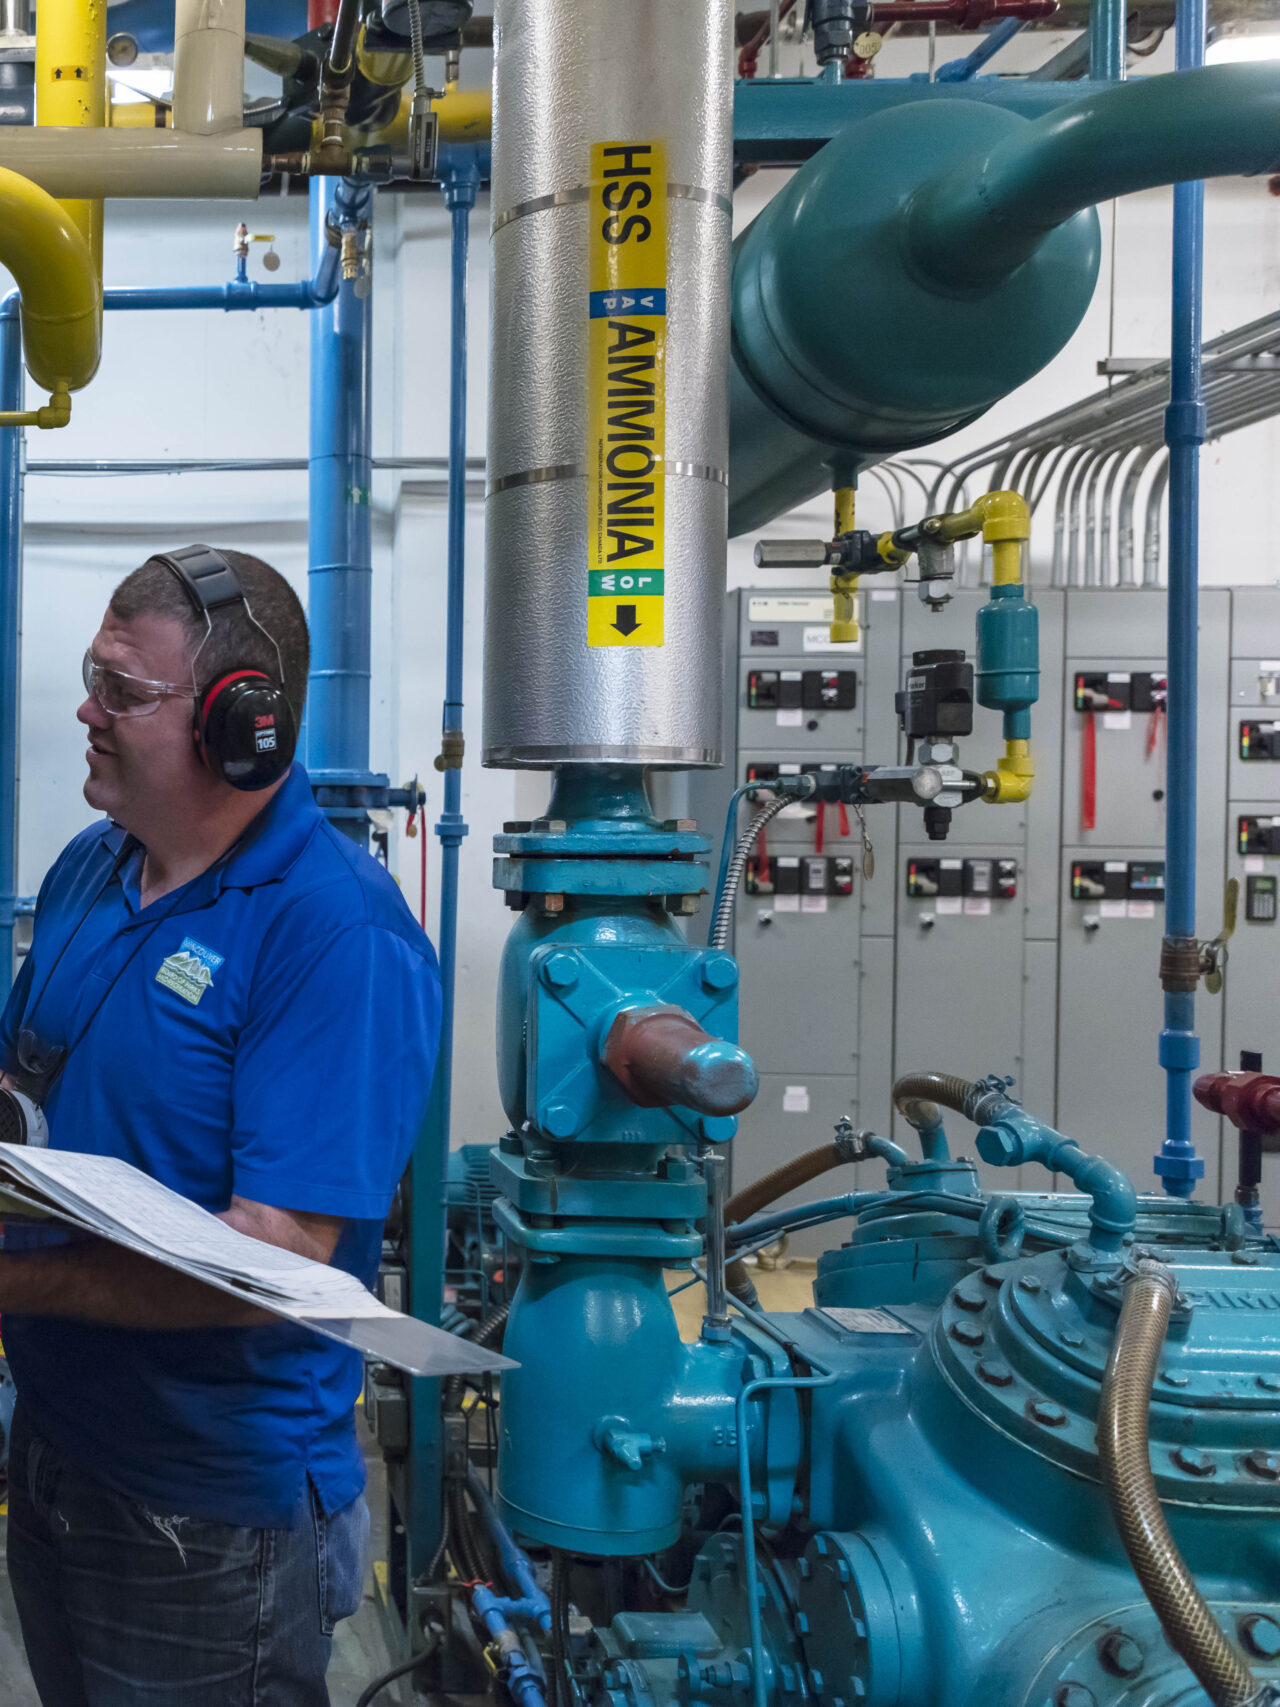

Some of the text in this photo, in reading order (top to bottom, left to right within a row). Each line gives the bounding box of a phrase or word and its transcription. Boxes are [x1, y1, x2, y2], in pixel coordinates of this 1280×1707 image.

[602, 145, 651, 245] HSS
[603, 295, 654, 310] VAP
[607, 320, 655, 563] AMMONIA
[601, 574, 652, 592] LOW
[254, 713, 275, 728] 3M
[257, 736, 276, 749] 105
